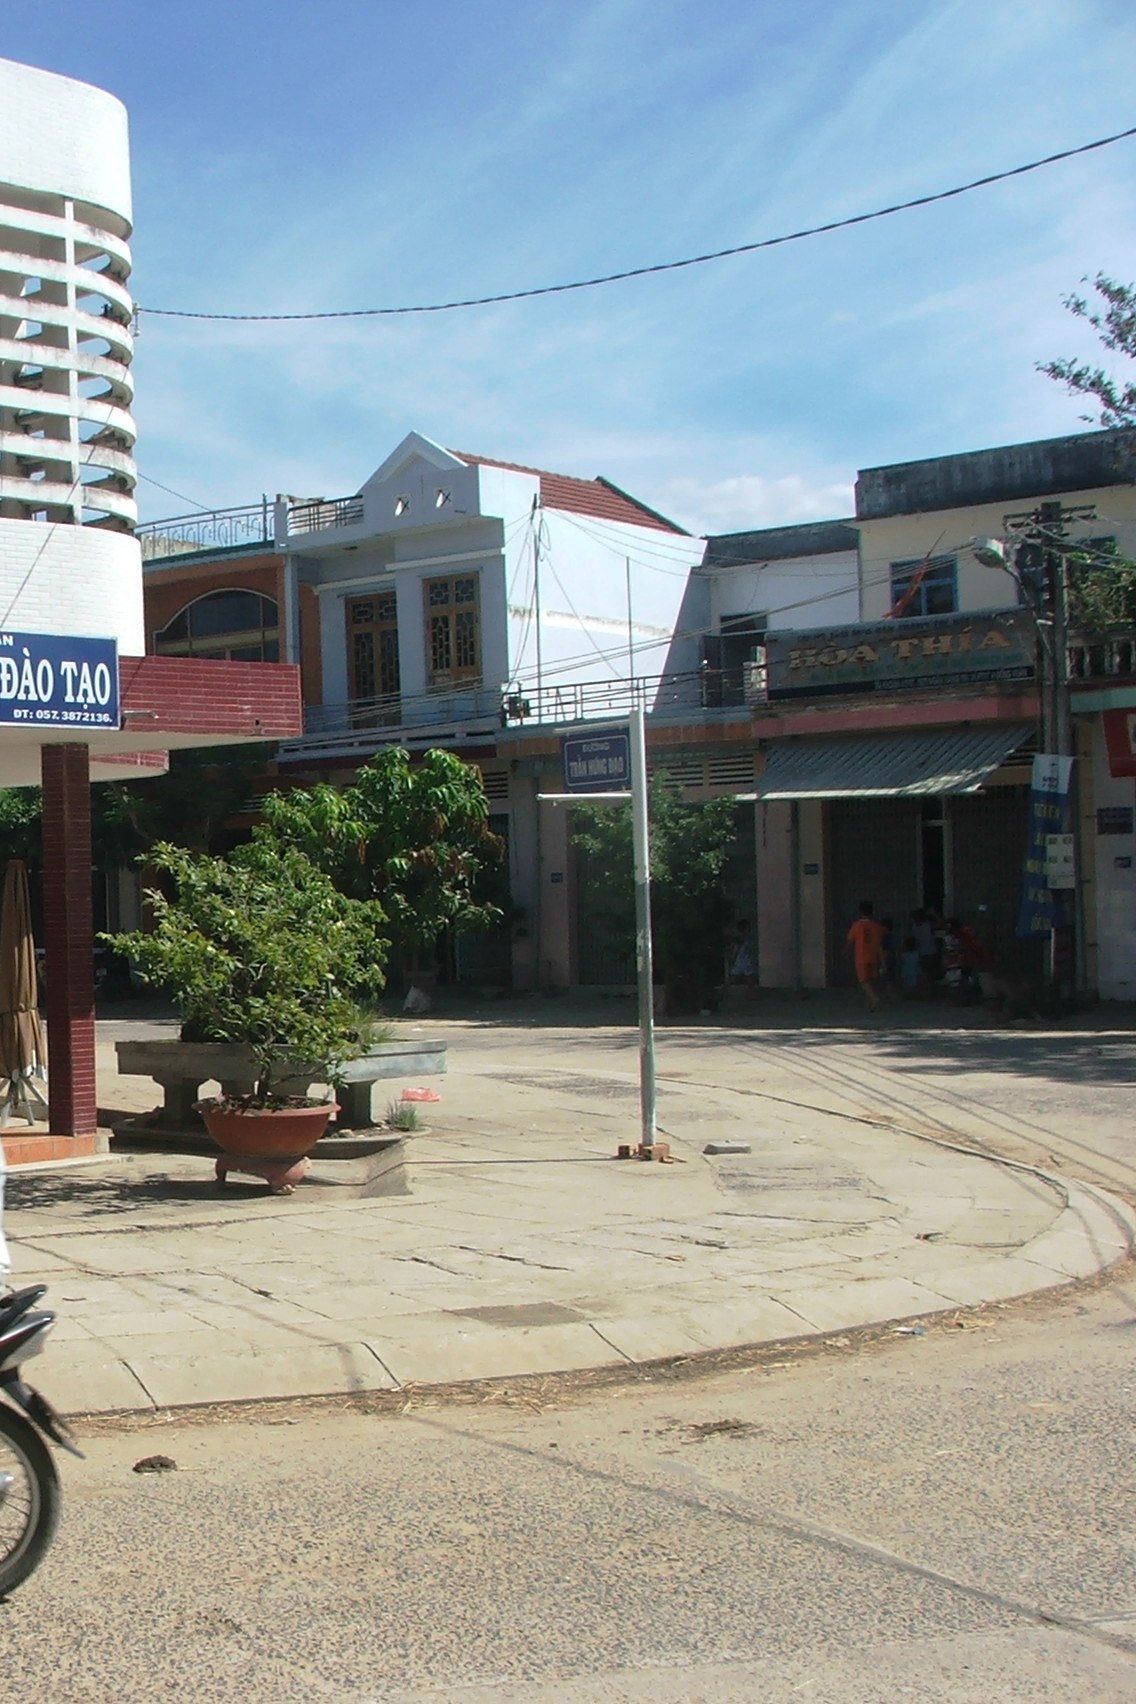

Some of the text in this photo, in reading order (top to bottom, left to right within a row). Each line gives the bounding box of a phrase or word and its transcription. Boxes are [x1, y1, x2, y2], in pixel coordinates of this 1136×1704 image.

[890, 626, 1011, 659] THÍA
[0, 647, 54, 703] ĐÀO
[60, 661, 111, 709] TẠO
